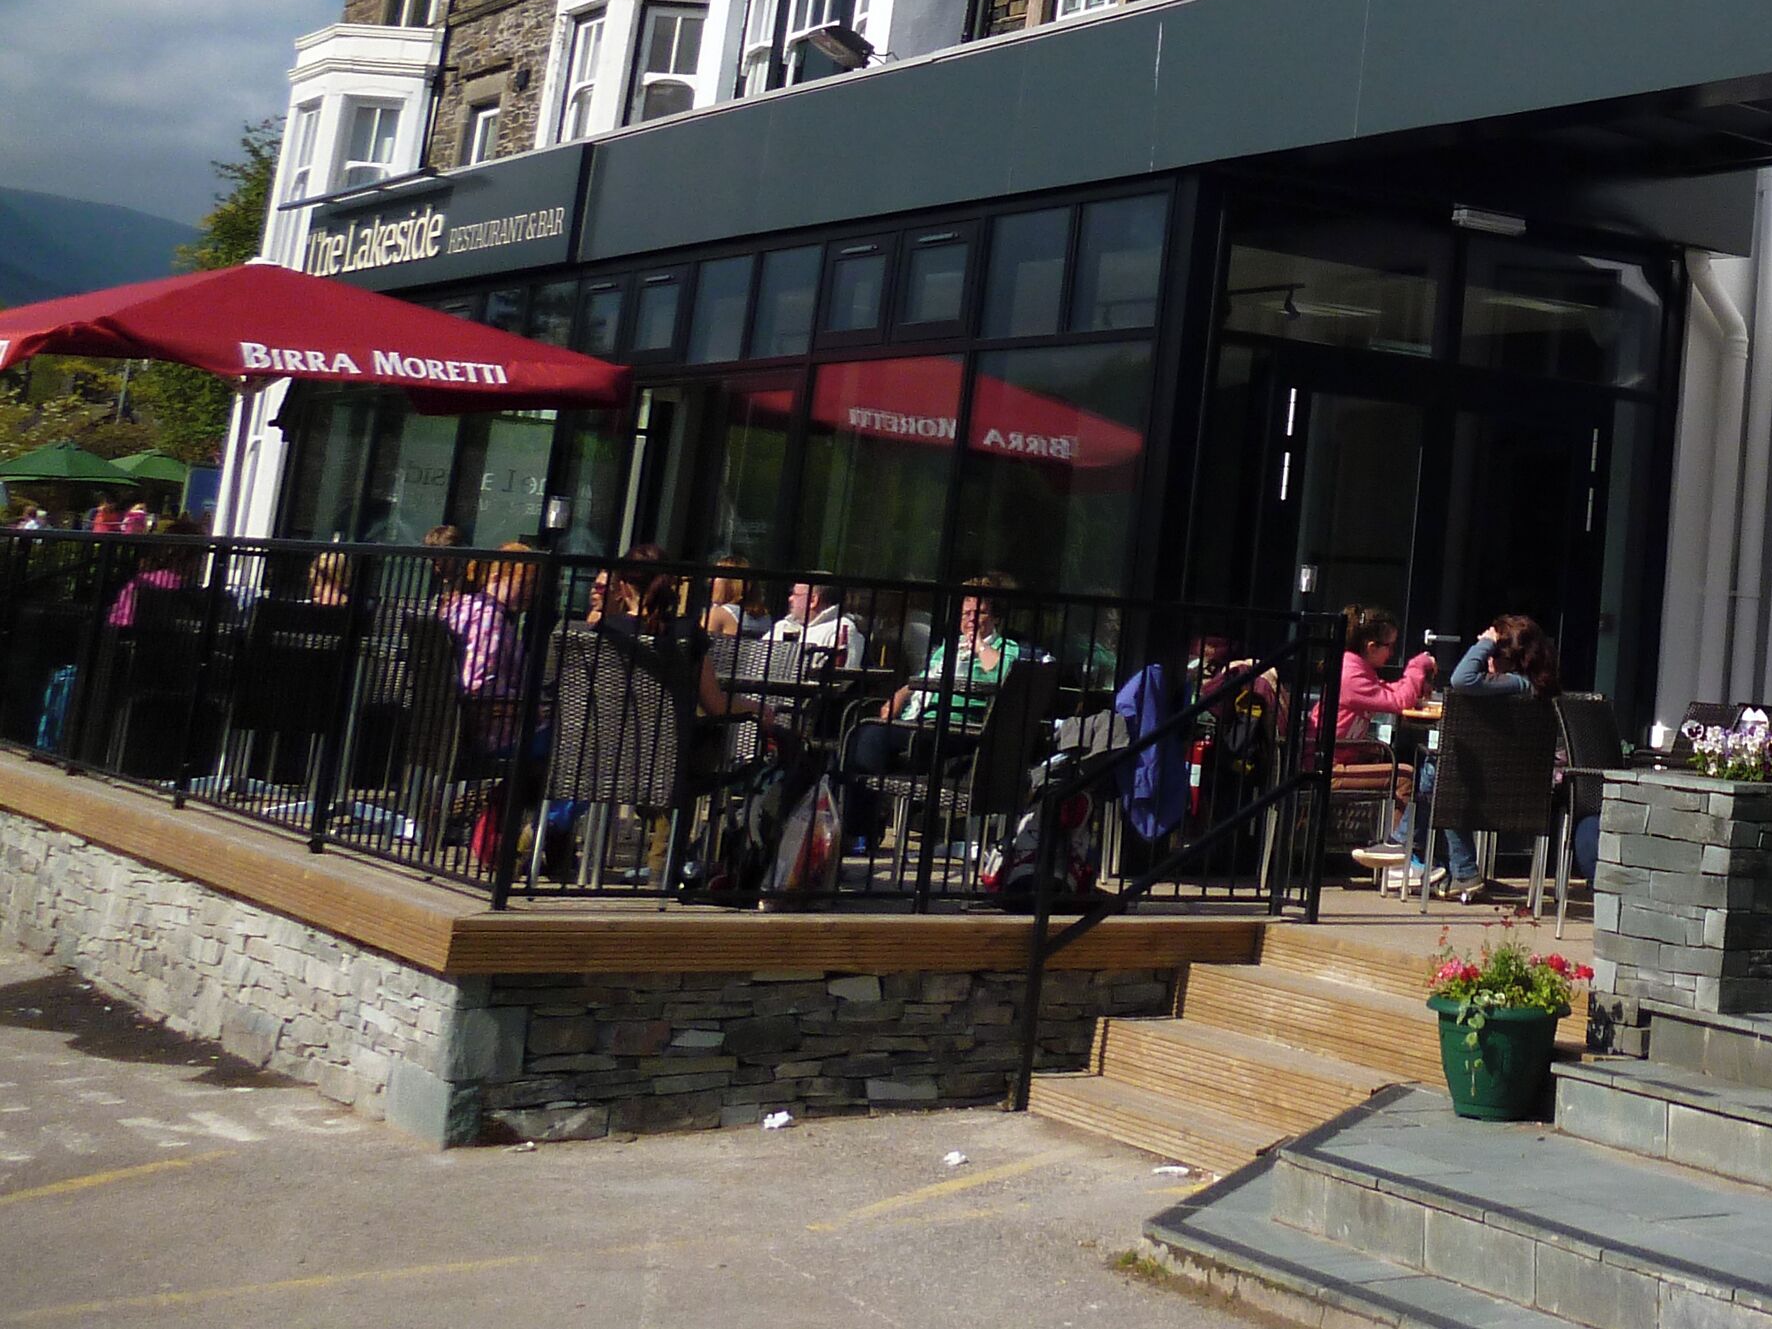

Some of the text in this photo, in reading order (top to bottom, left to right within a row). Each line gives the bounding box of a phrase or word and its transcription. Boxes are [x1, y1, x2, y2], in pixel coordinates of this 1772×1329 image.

[307, 204, 566, 277] The Lakeside RESTAURANT & BAR
[239, 341, 508, 384] BIRRA MORETTI
